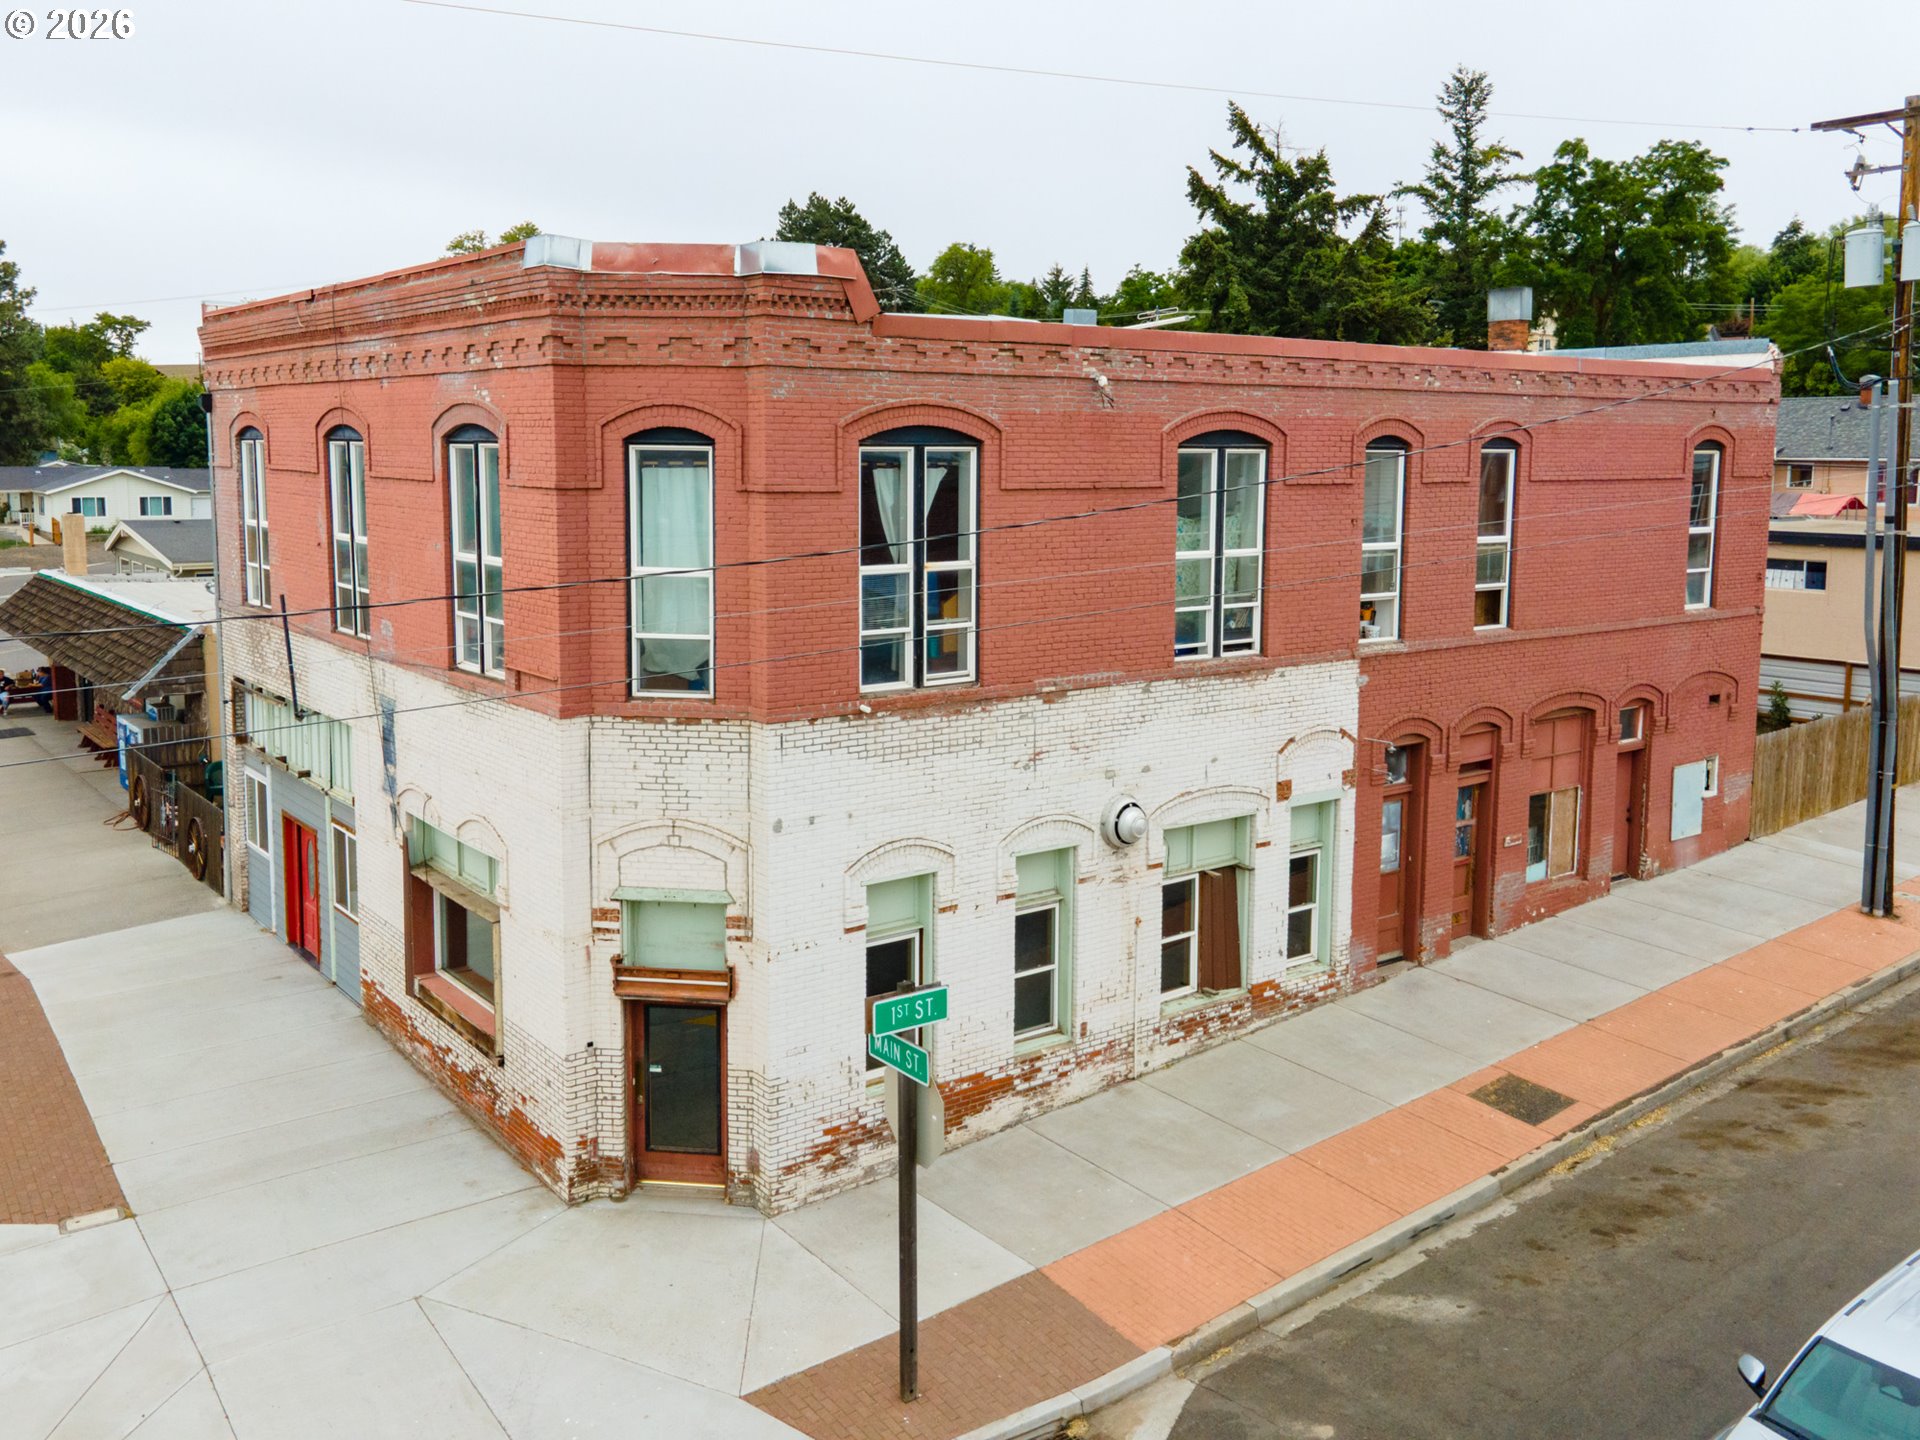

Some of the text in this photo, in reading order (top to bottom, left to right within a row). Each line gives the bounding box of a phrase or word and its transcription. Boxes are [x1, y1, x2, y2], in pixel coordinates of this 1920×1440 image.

[891, 997, 938, 1025] 1ST ST.
[874, 1036, 922, 1075] MAIN ST.
